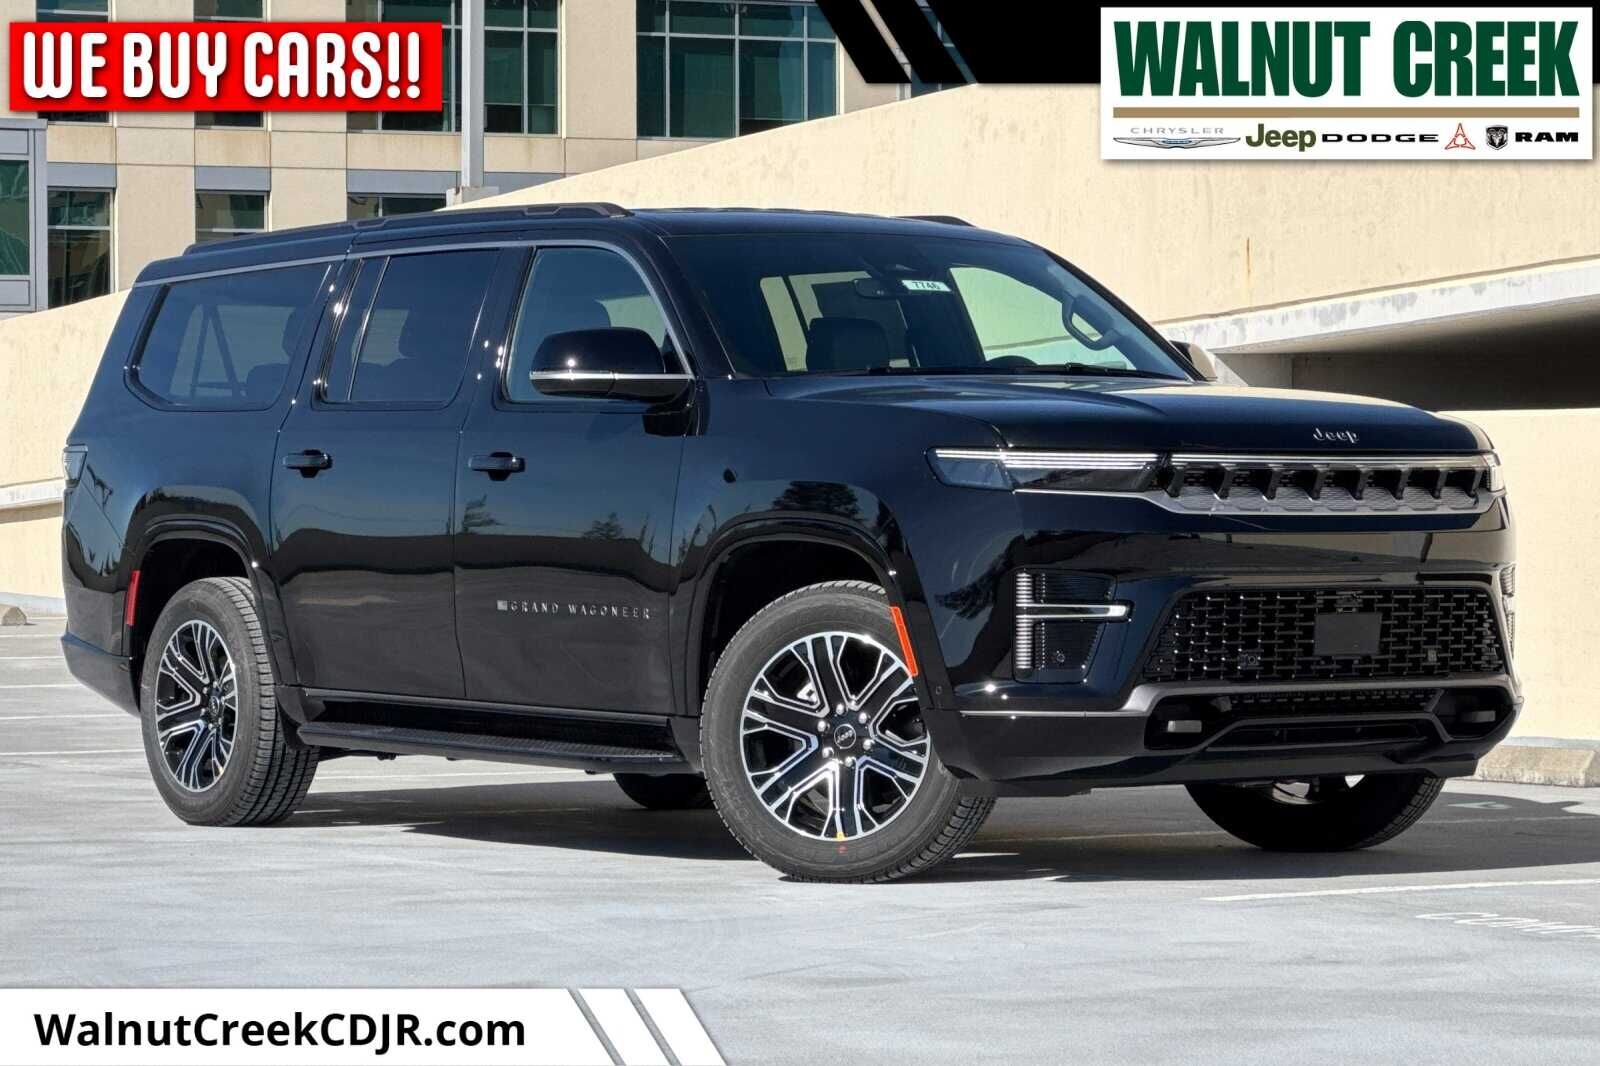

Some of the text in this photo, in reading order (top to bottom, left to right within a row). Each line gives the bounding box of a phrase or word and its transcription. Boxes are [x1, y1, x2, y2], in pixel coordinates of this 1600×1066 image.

[1312, 427, 1360, 444] Jeep
[511, 601, 651, 619] GRAND WAGONEER
